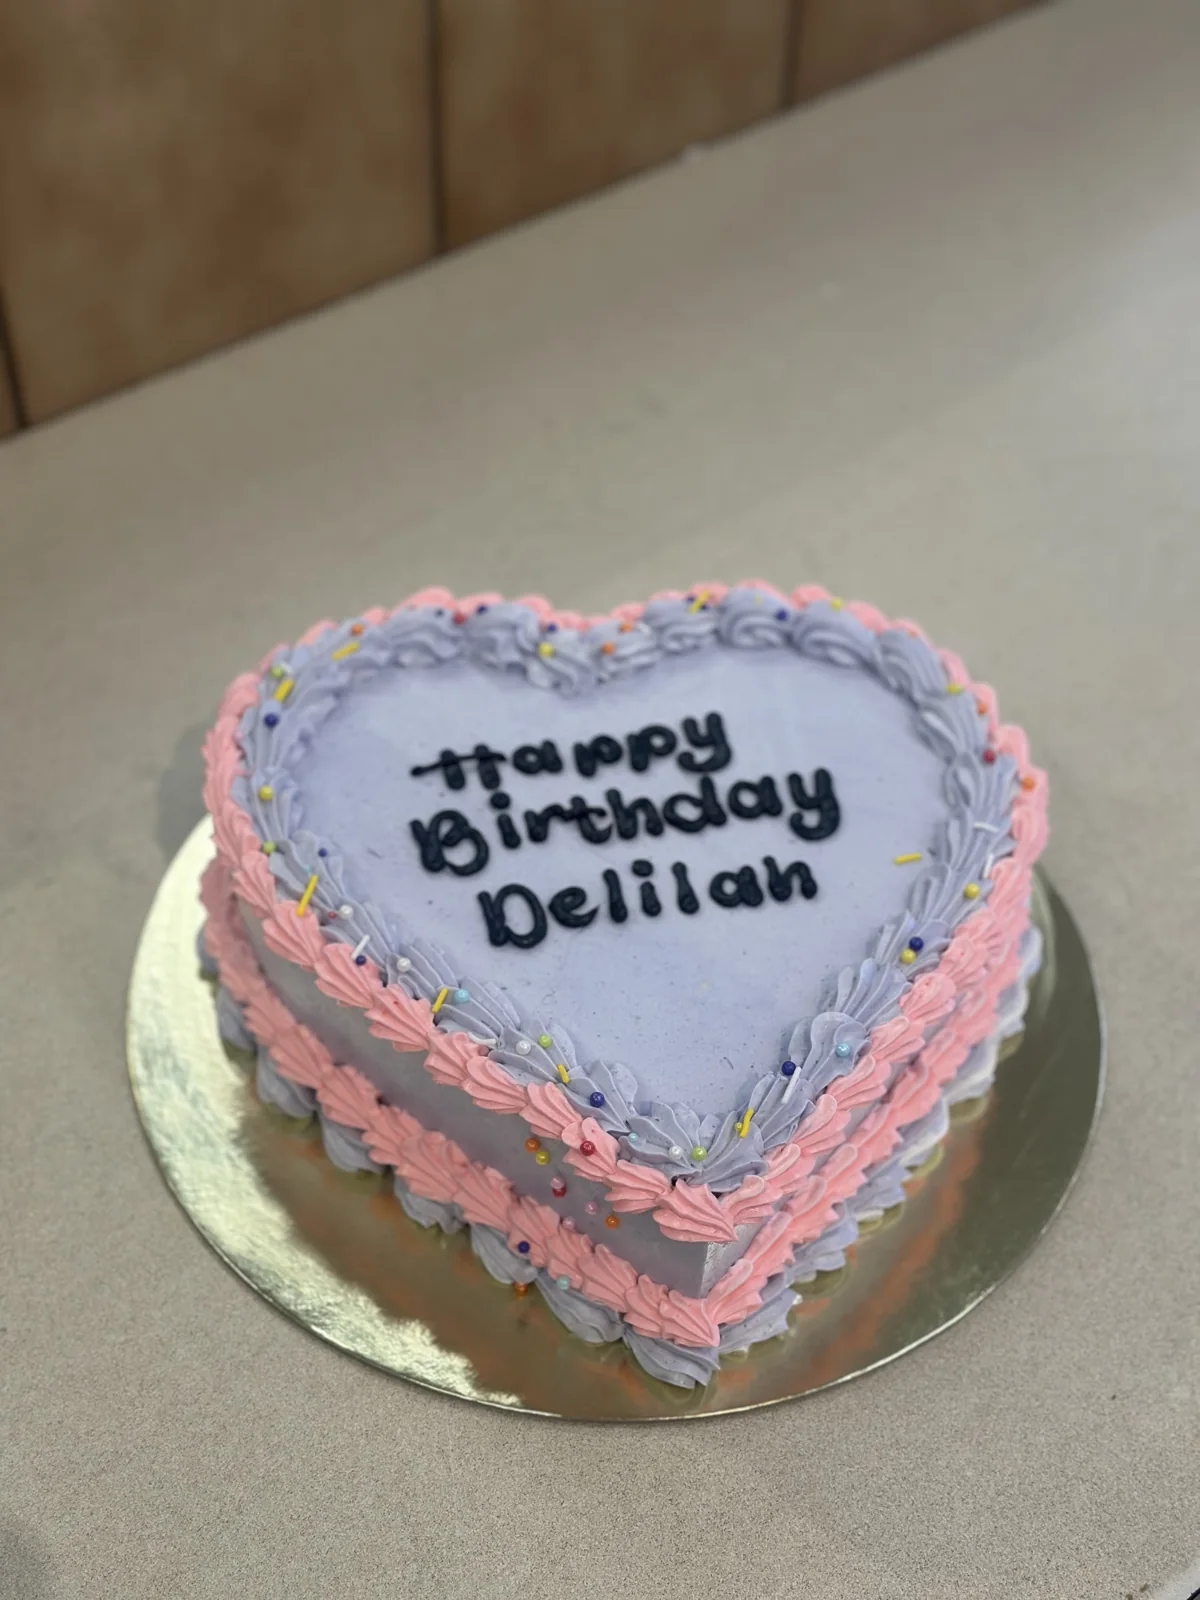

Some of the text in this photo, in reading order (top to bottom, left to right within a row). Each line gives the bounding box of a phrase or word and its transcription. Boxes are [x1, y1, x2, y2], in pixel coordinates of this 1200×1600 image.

[411, 712, 732, 790] Happy
[410, 768, 841, 876] Birthday
[477, 856, 818, 949] Delilah
